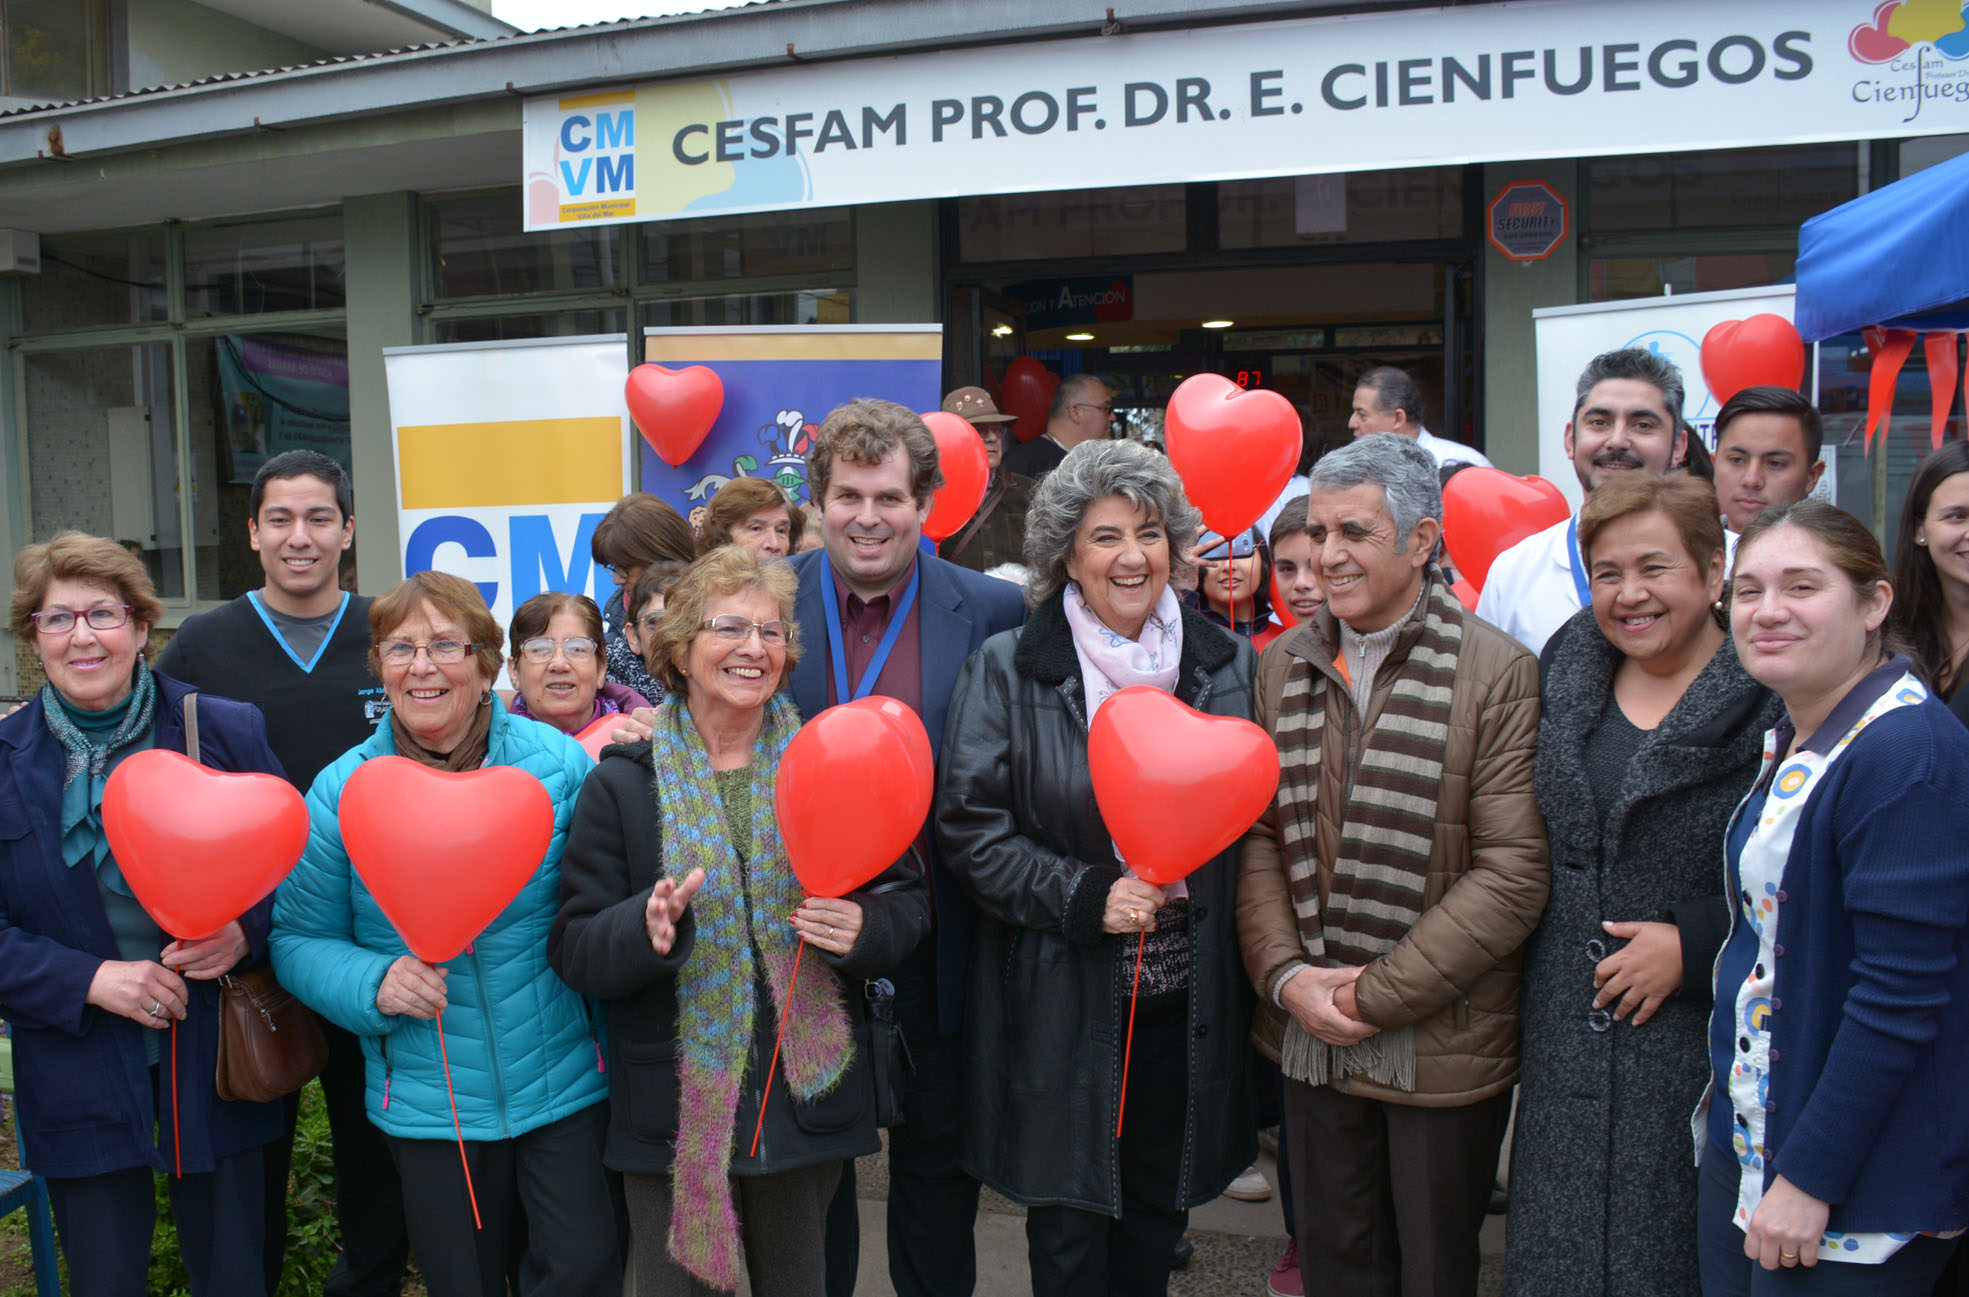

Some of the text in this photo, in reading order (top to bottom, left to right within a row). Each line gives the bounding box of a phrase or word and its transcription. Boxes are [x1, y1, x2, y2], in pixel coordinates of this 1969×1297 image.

[673, 31, 1812, 165] CESFAM PROF. DR. E. CIENFUEGOS
[561, 110, 634, 153] CM
[559, 154, 634, 196] VM
[1509, 201, 1546, 216] FIRST
[1498, 216, 1558, 231] SECURITY
[1237, 370, 1263, 387] 87
